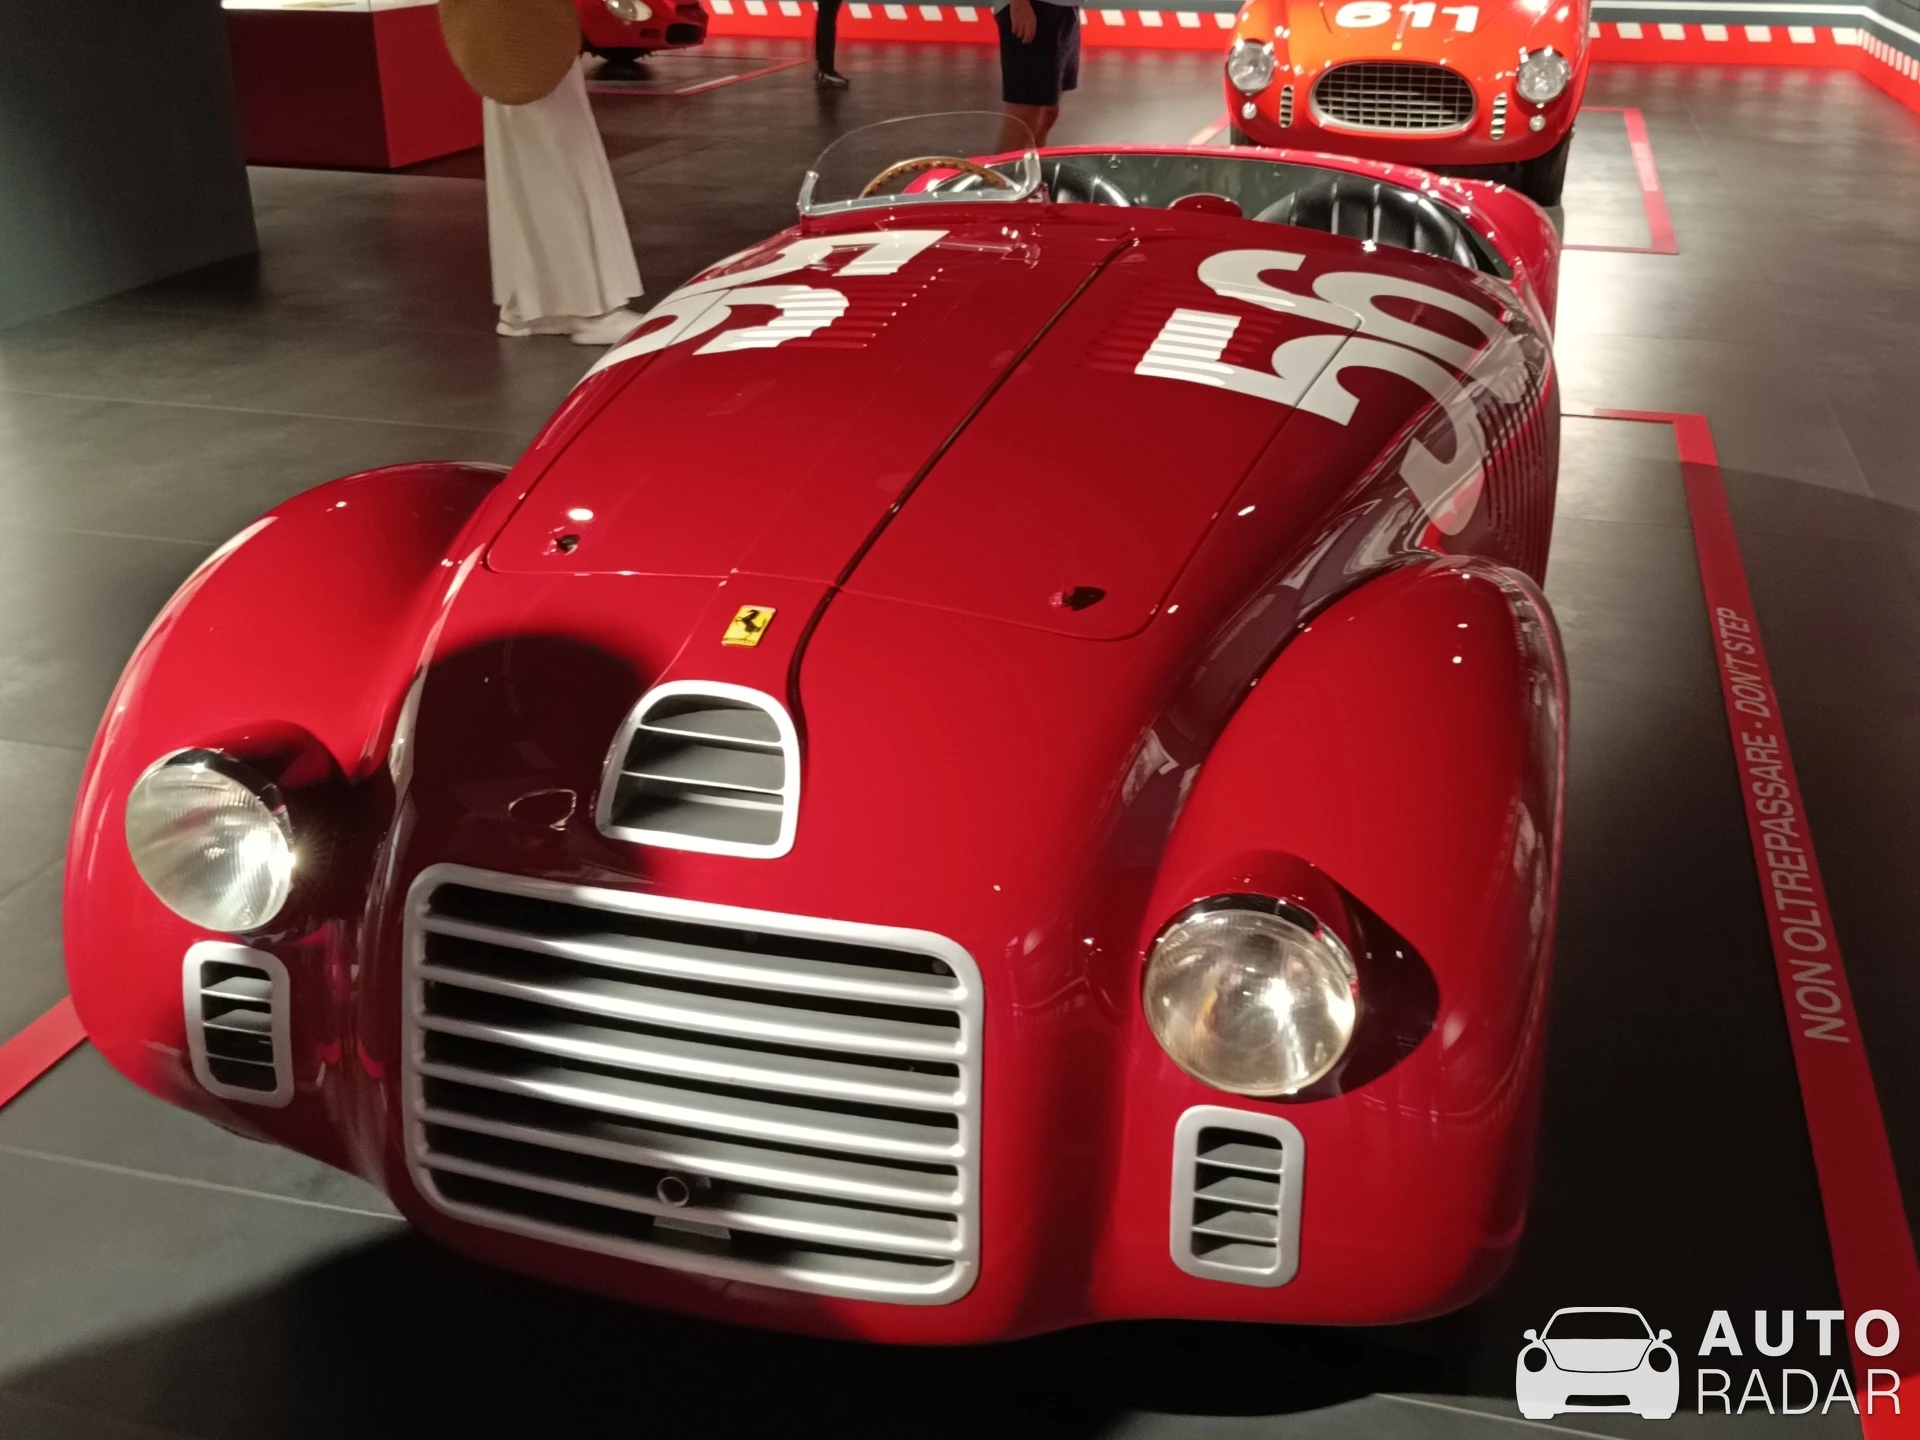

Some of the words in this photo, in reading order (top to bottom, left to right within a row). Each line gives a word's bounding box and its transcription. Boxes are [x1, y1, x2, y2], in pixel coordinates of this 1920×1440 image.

[1335, 1, 1480, 33] 611
[1134, 249, 1530, 536] 56
[1717, 607, 1756, 655] STEP
[1724, 653, 1771, 718] DON'T
[1742, 731, 1828, 953] OLTREPASSARE
[1790, 959, 1850, 1043] NON
